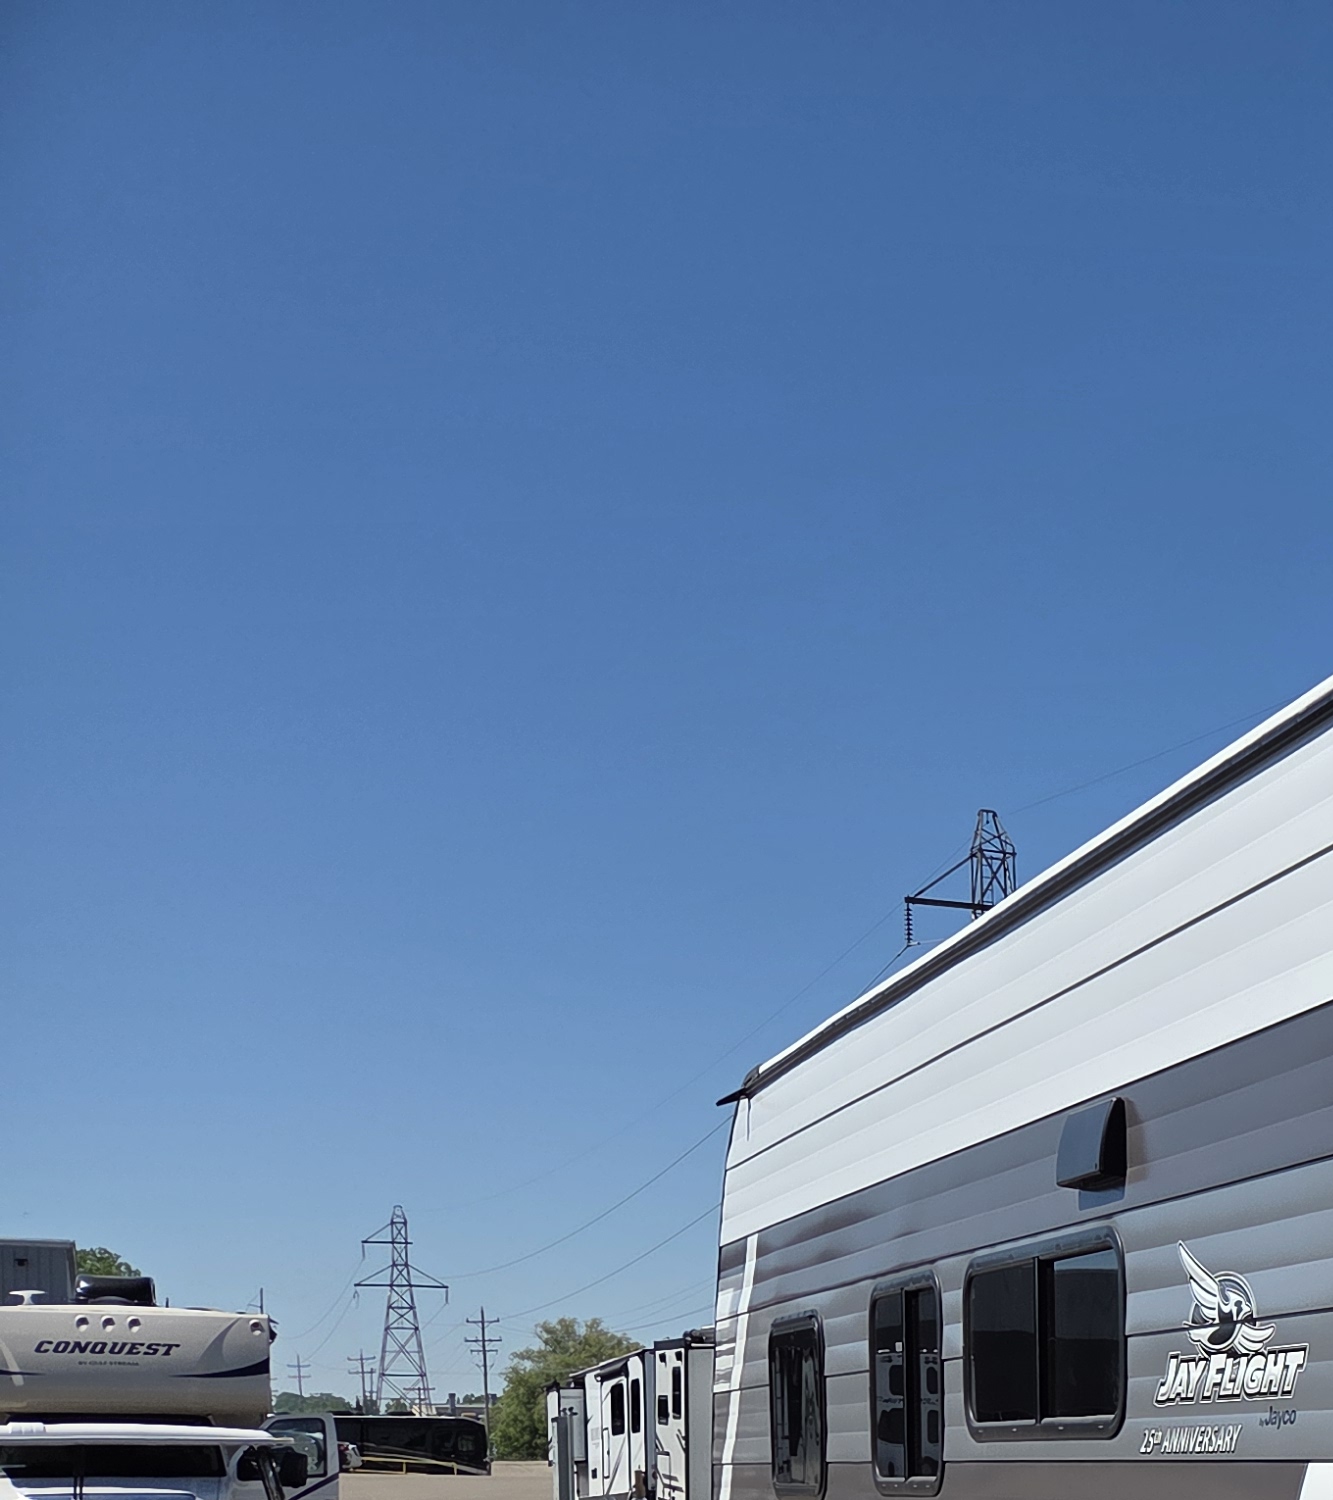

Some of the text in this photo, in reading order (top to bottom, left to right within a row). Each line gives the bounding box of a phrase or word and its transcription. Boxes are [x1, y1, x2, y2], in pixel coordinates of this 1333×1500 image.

[34, 1340, 181, 1357] CONQUEST
[1154, 1343, 1310, 1407] JAY FLIGHT
[1264, 1405, 1298, 1430] Jayco
[1139, 1424, 1243, 1455] 25th ANNIVERSARY
